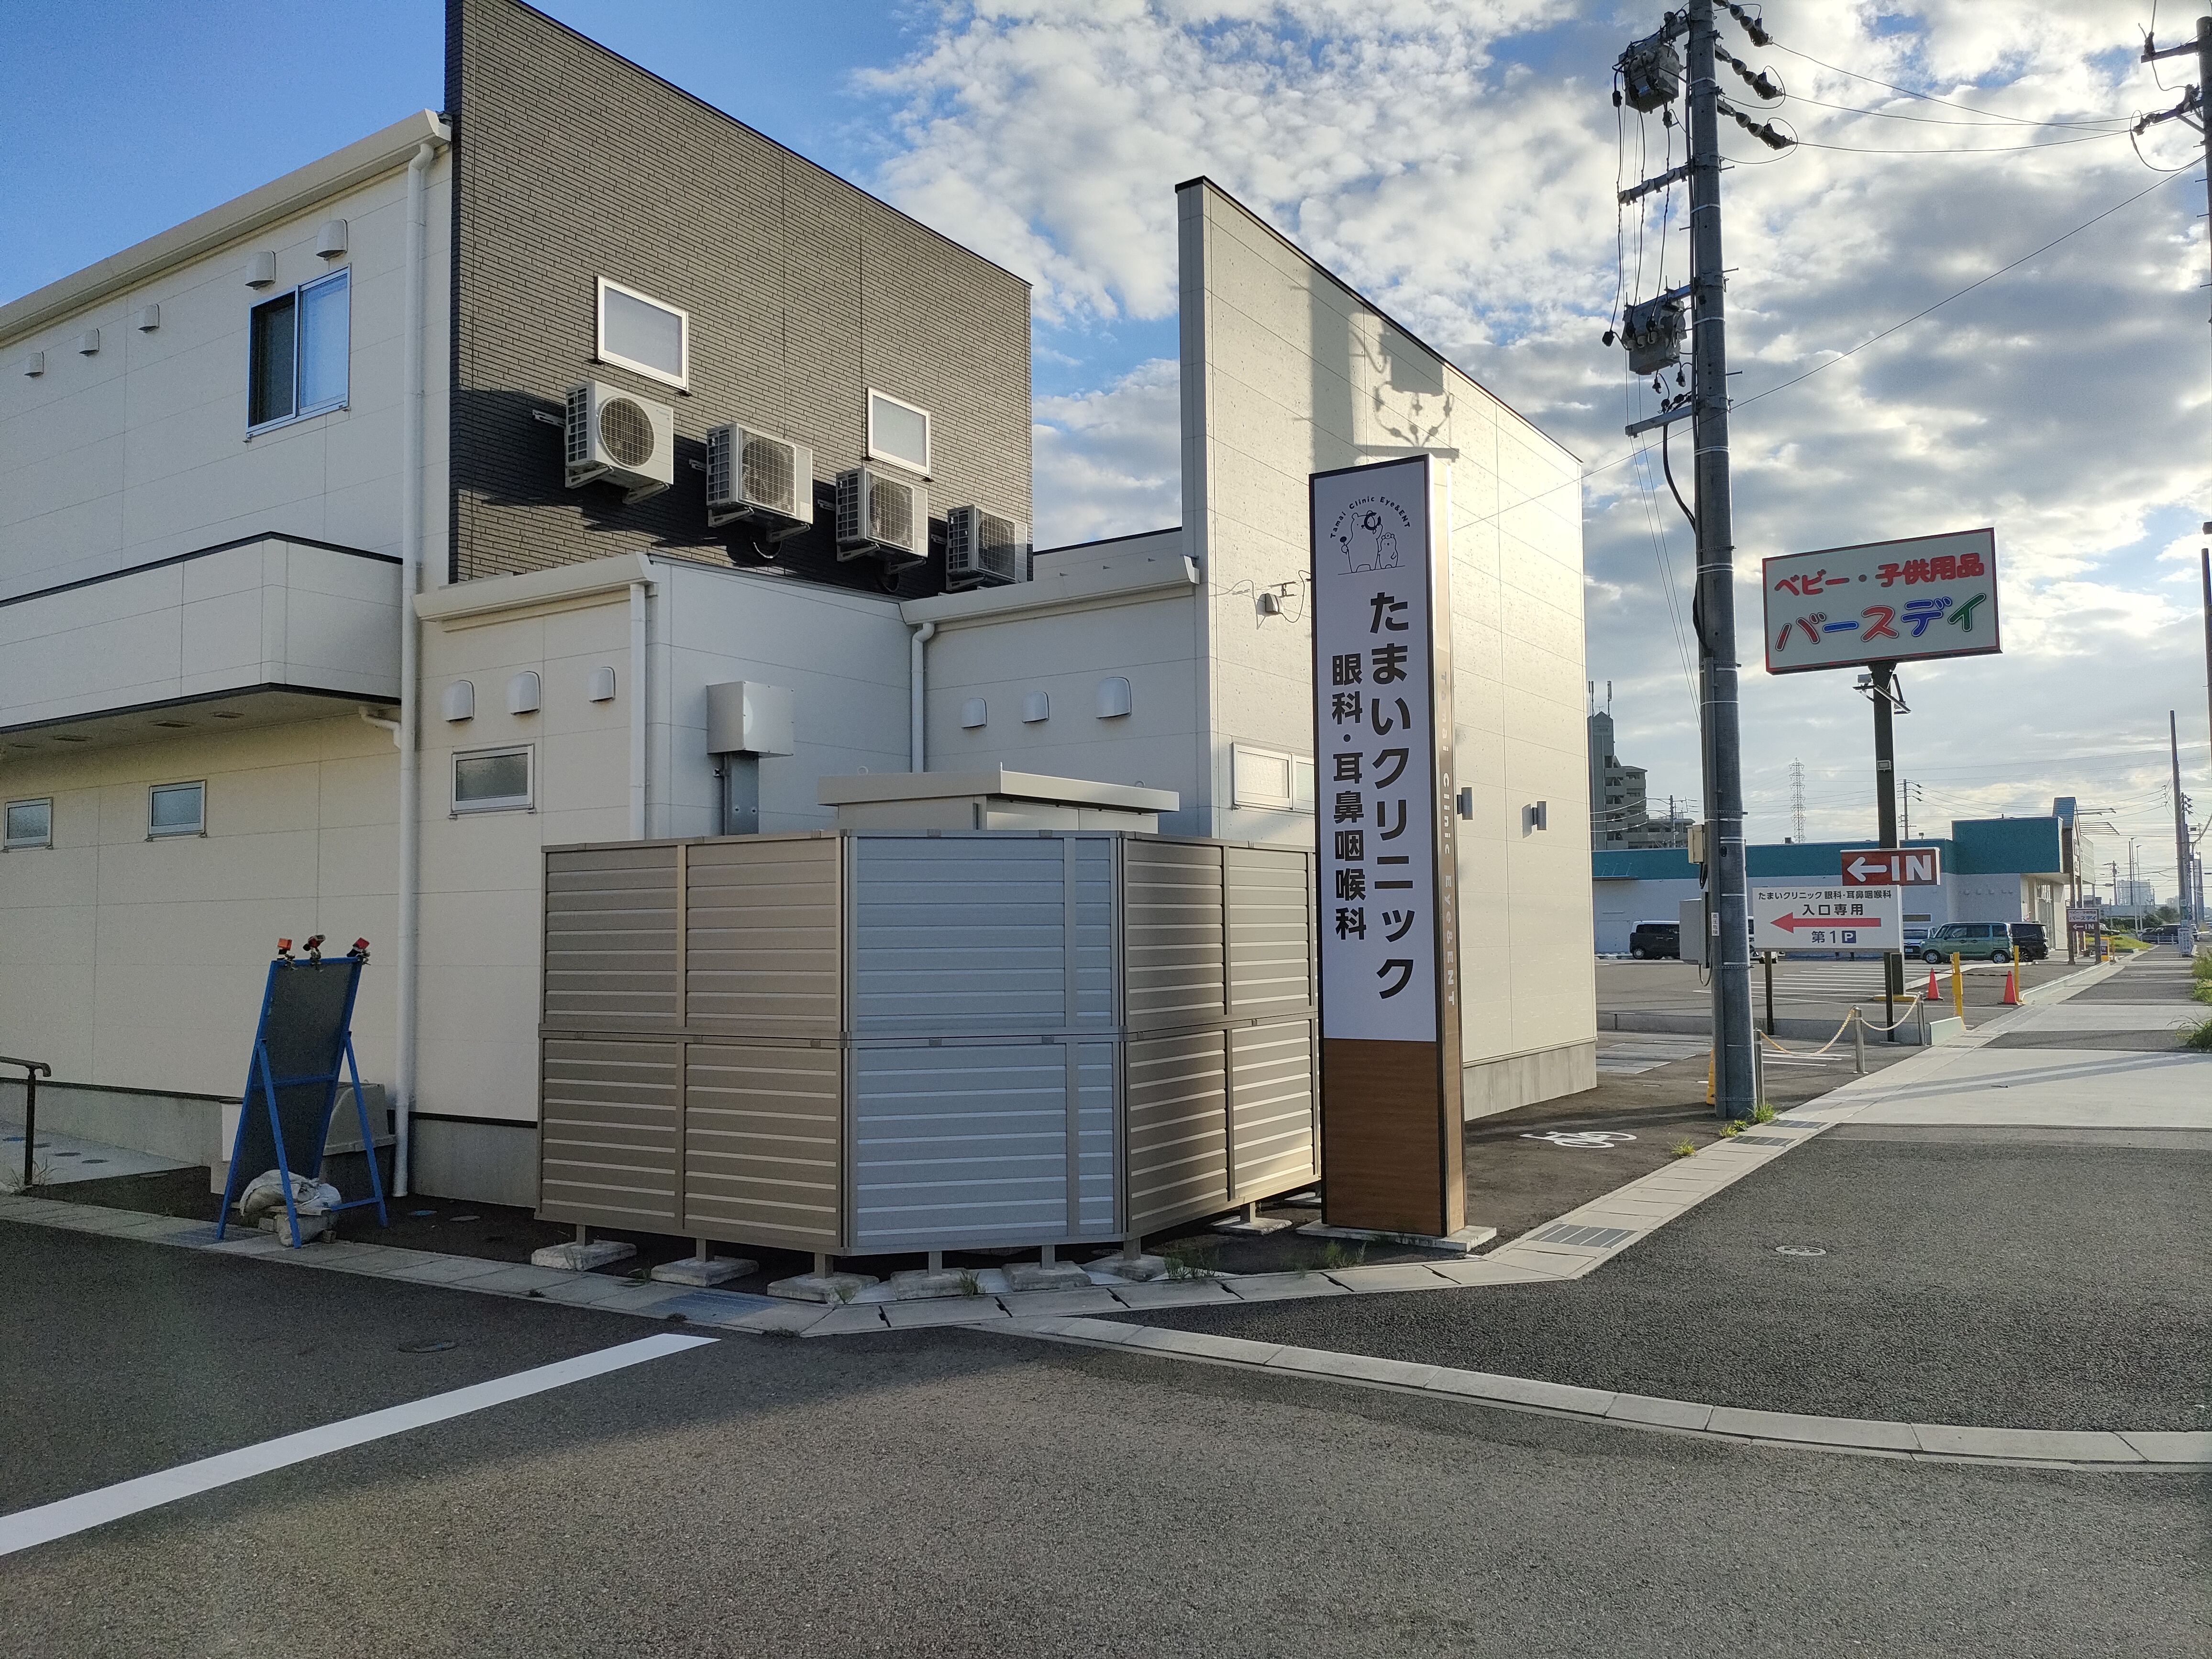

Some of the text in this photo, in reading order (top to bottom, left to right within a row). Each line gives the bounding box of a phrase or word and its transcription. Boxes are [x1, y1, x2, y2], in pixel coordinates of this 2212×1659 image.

[1330, 496, 1410, 539] Tamai Clinic Eye&ENT
[1774, 552, 1985, 596] ベビー・子供用品
[1331, 653, 1367, 940] 眼科・耳鼻咽喉科
[1370, 592, 1416, 999] たまいクリニック
[1891, 855, 1932, 881] IN
[1759, 890, 1891, 900] たまいクリニック 眼科・耳鼻咽喉科
[1802, 904, 1863, 916] 入口専用
[1444, 875, 1455, 1006] Eye&ENT
